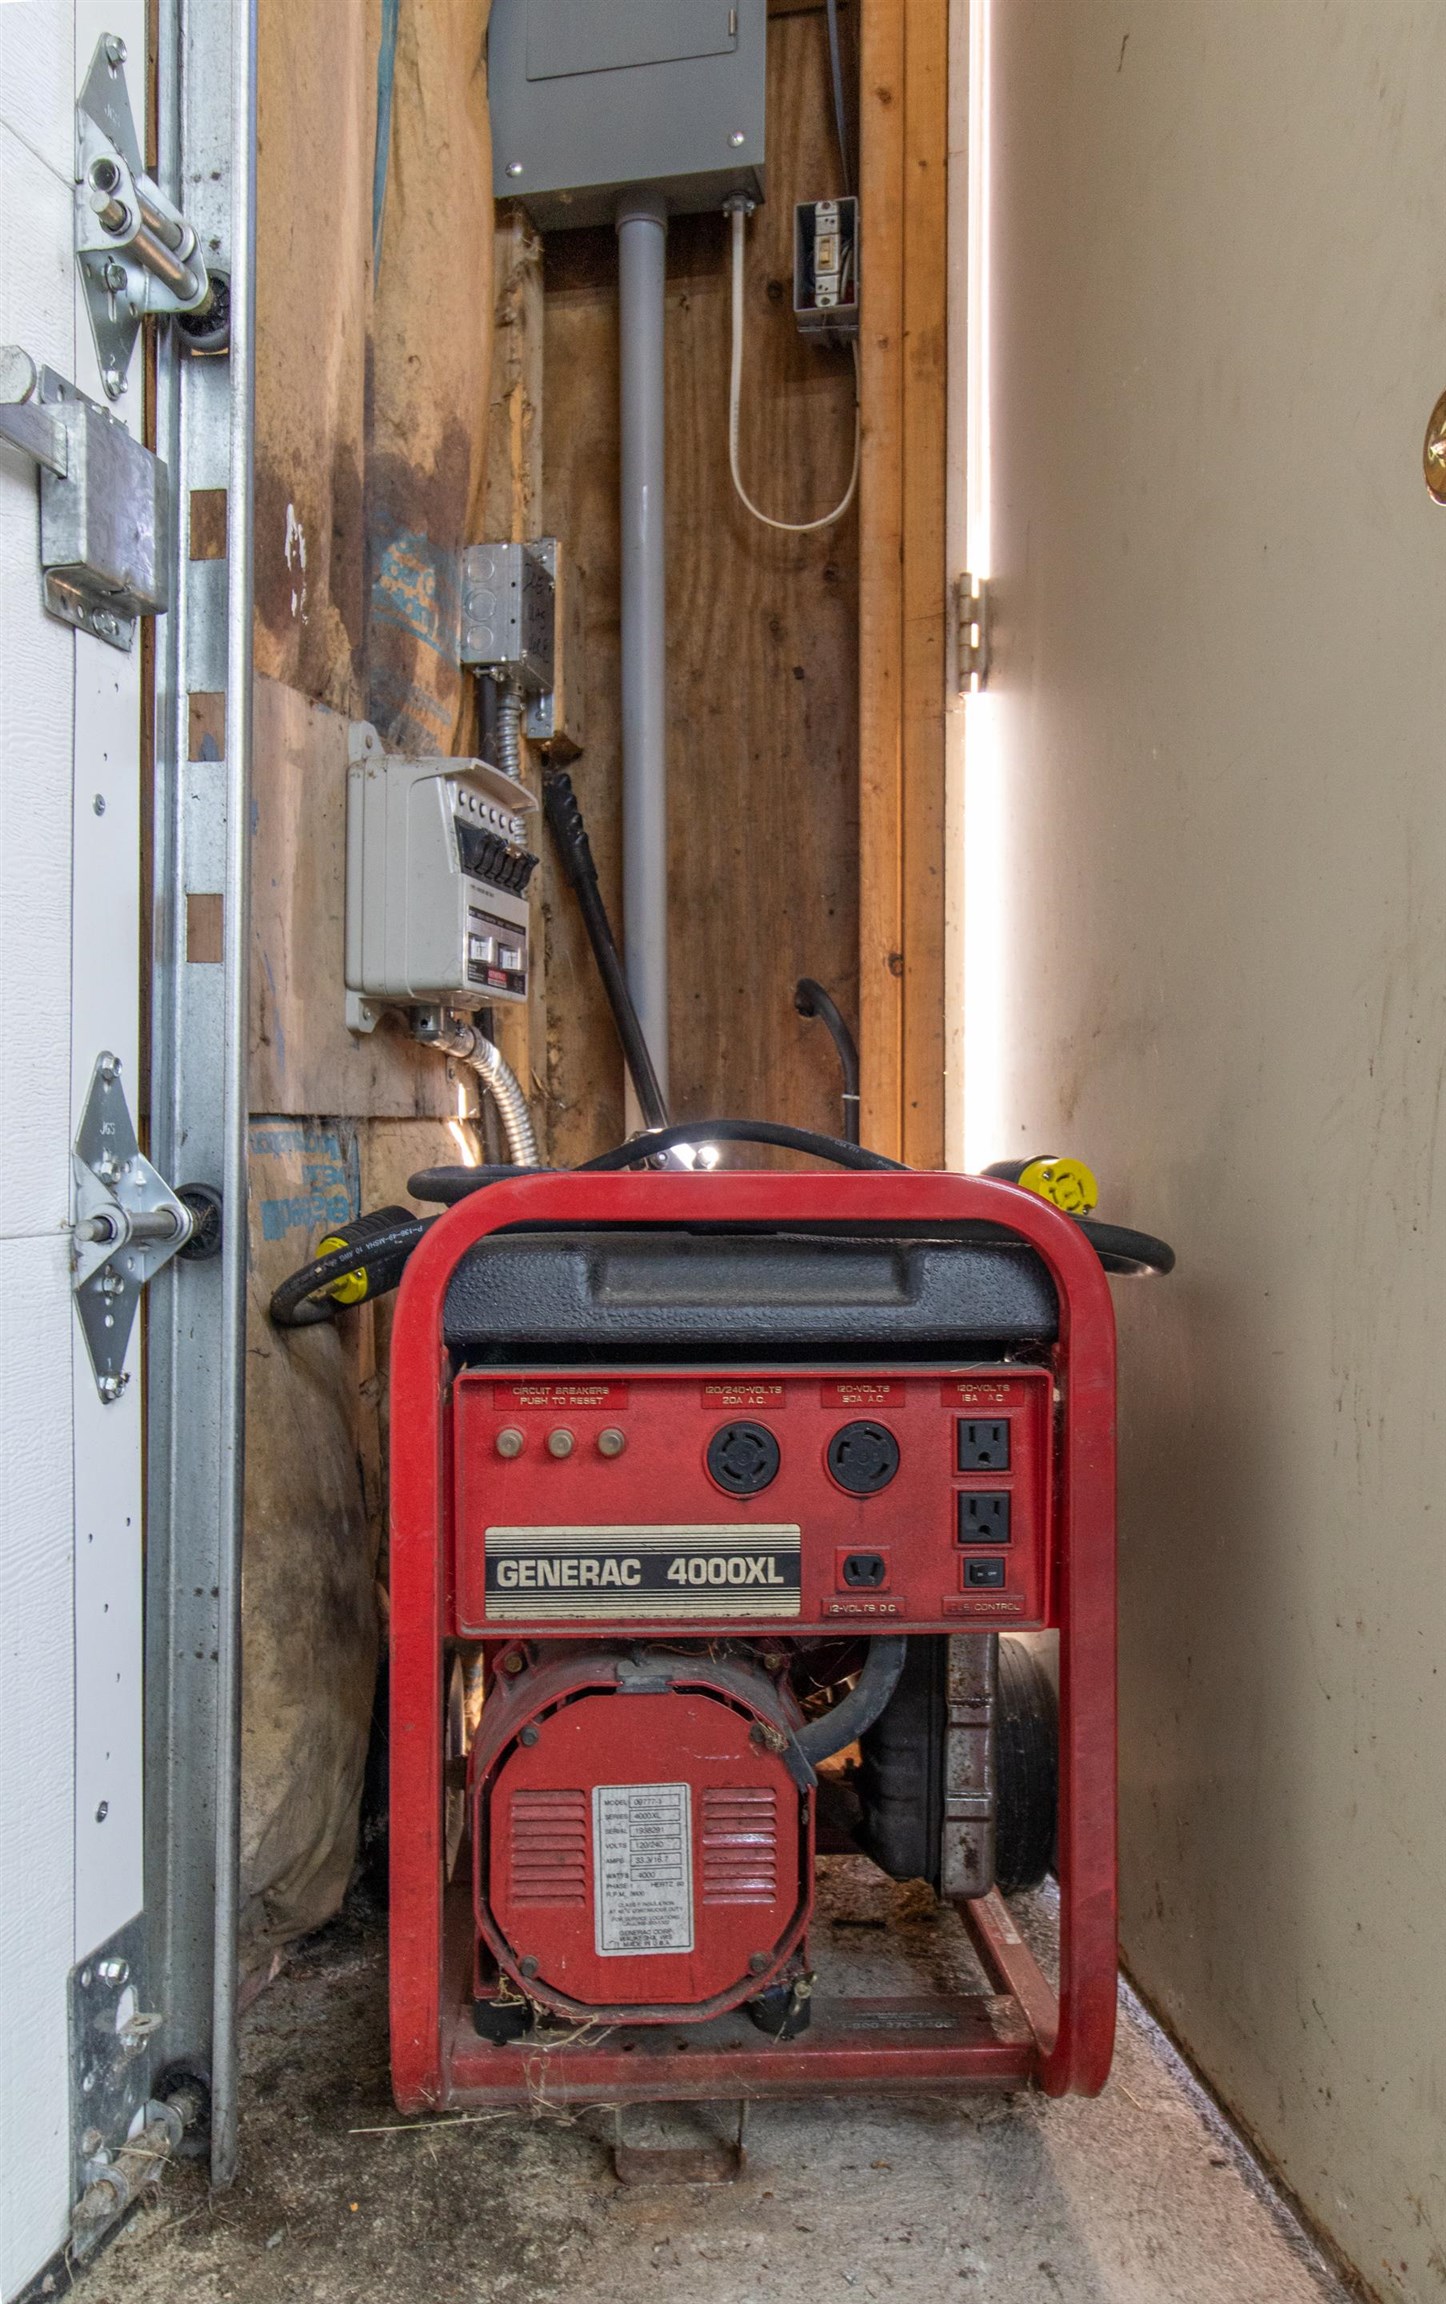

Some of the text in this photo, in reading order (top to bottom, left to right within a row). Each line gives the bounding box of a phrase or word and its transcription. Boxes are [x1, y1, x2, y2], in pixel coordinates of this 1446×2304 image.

[512, 1386, 610, 1396] CIRCUIT BREAKERS
[705, 1385, 782, 1395] 120/240-VOLTS
[836, 1384, 891, 1394] 120-VOLTS
[956, 1384, 1010, 1393] 120-VOLTS
[520, 1396, 604, 1405] PUSH TO RESET
[722, 1396, 743, 1405] 20A
[961, 1393, 978, 1402] 15A
[496, 1555, 785, 1588] GENERAC 4000XL
[829, 1603, 876, 1614] 12-VOLTS
[974, 1602, 1021, 1612] CONTROL
[604, 1813, 628, 1821] SERIES
[605, 1842, 628, 1850] VOLTS
[605, 1857, 625, 1865] AMPS
[606, 1872, 629, 1880] WATTS
